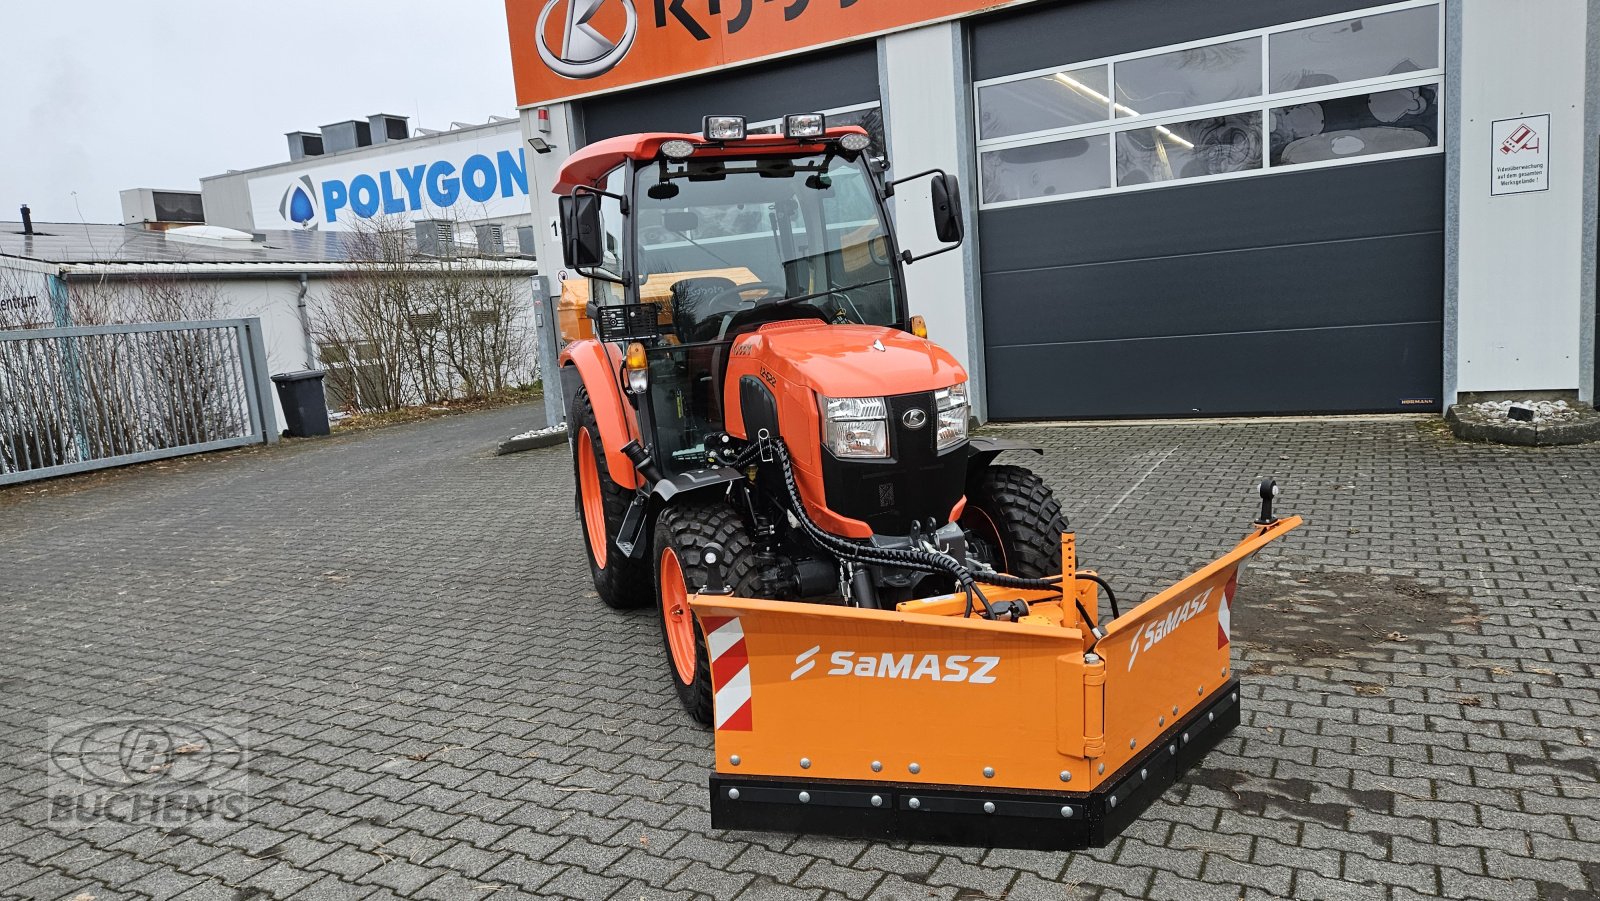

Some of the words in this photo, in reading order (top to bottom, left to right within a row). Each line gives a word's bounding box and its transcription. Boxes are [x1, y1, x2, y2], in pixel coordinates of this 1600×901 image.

[321, 147, 529, 222] POLYGON
[1518, 170, 1542, 178] gesamten
[0, 295, 38, 311] entrum
[1143, 585, 1216, 653] SaMASZ
[827, 650, 1001, 684] SaMASZ
